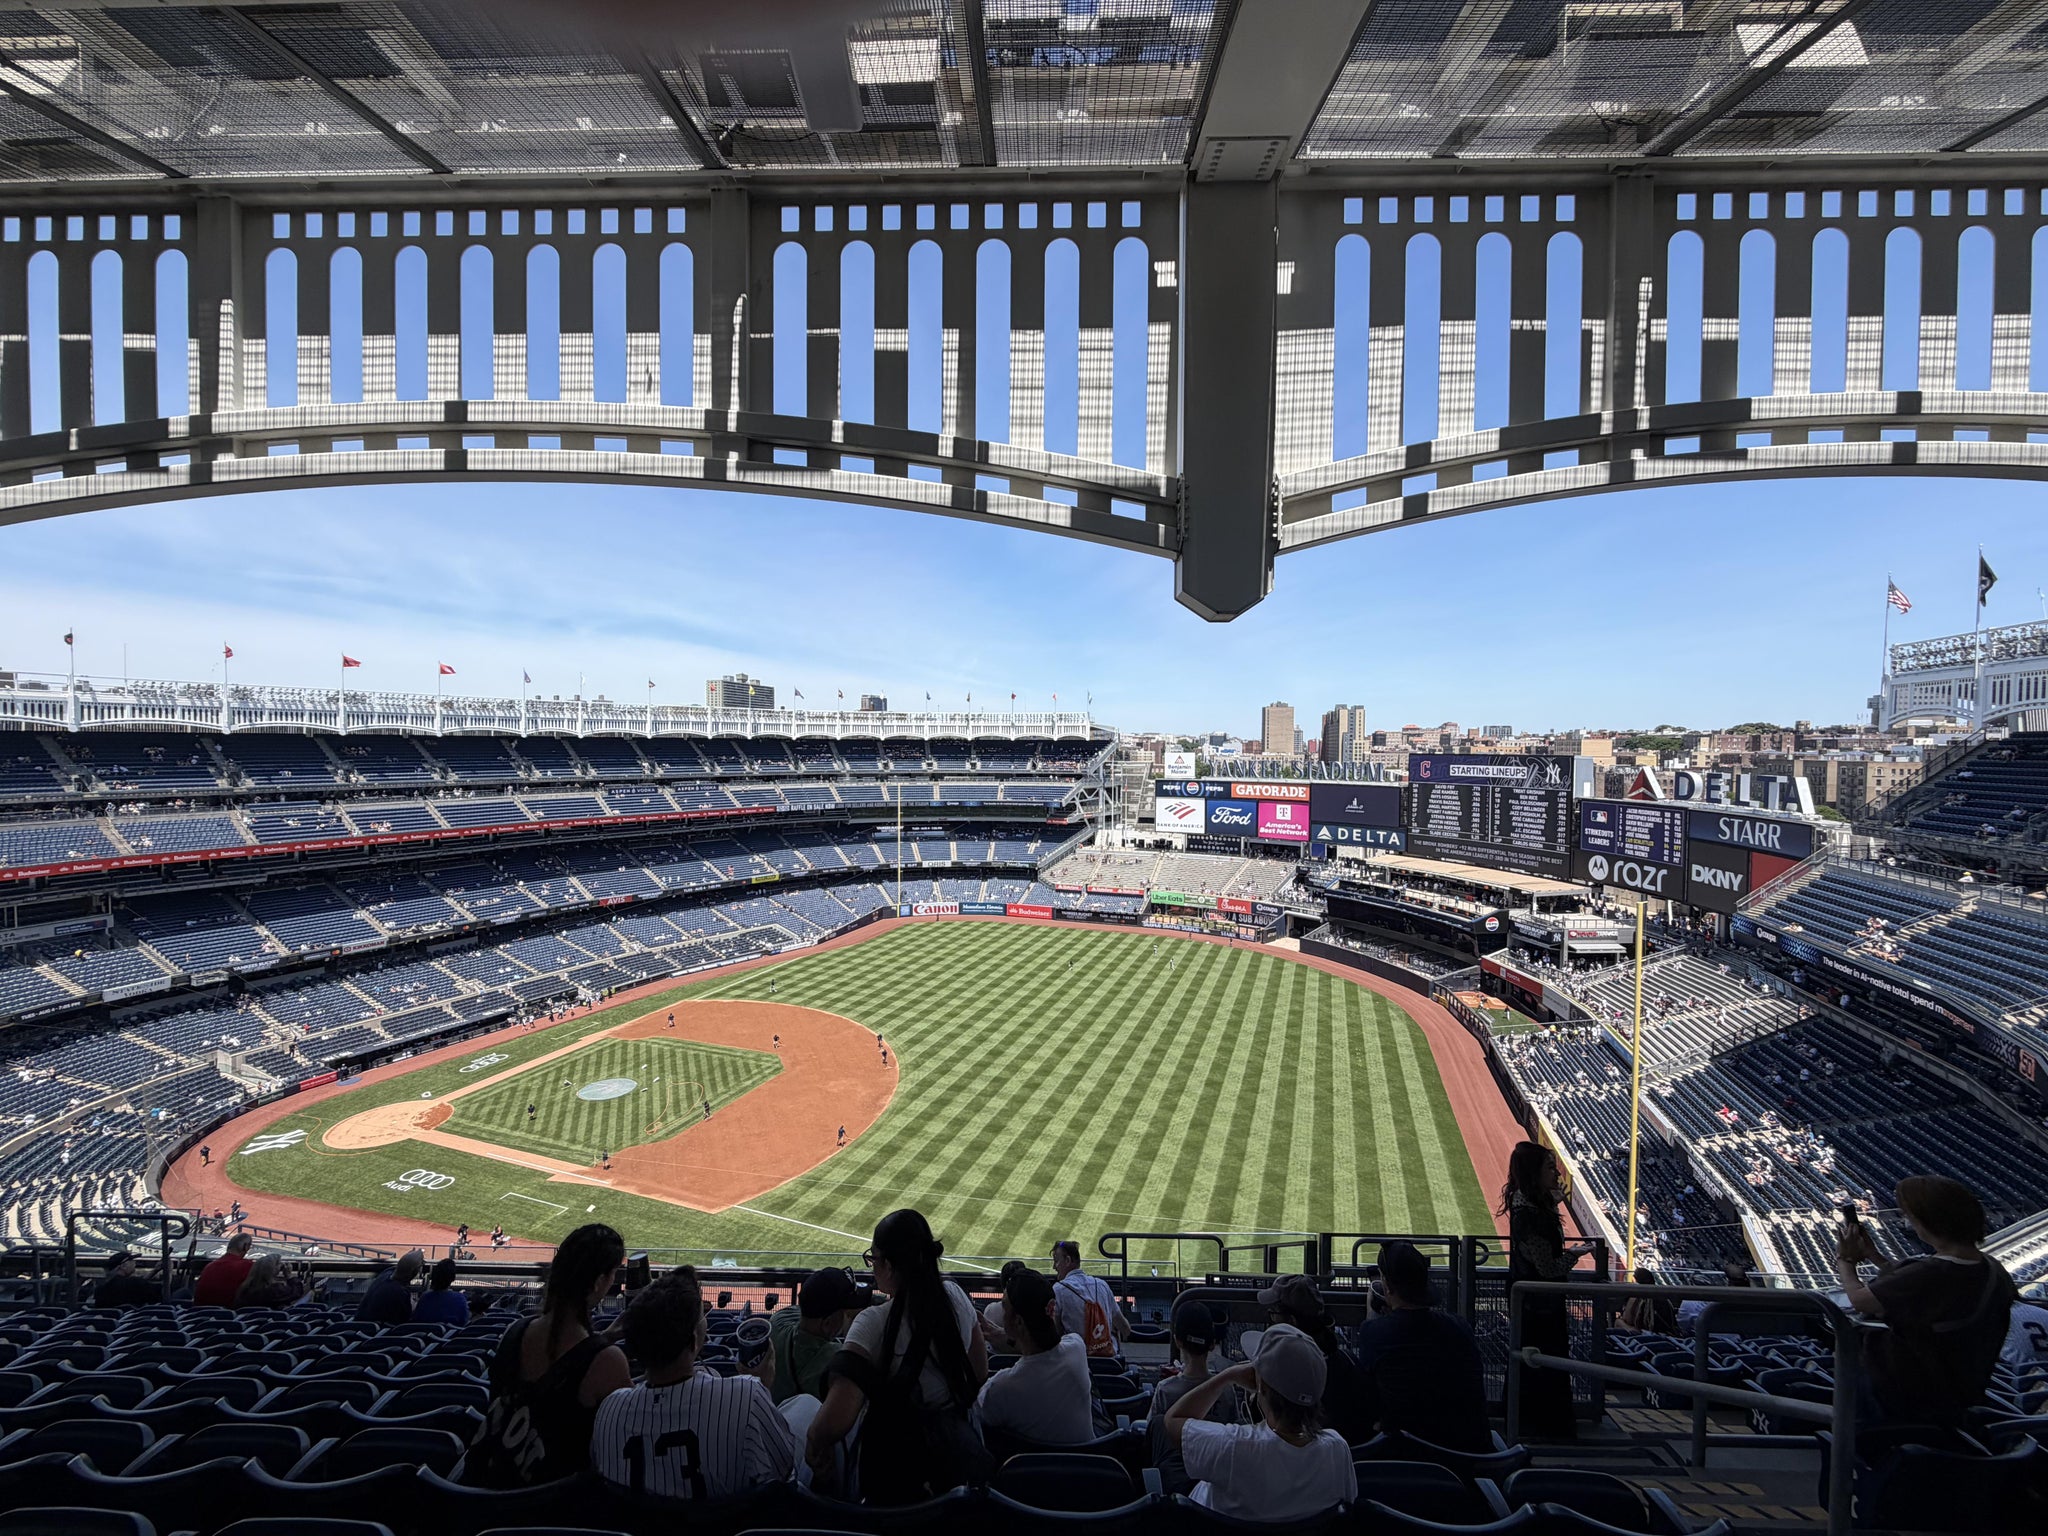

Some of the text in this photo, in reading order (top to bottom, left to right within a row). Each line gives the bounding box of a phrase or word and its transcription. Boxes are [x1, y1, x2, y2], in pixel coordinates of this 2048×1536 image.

[1209, 759, 1385, 782] YANKEE STADIUM
[1451, 767, 1526, 778] STARTING LINEUPS
[1236, 785, 1306, 798] GATORADE
[1674, 769, 1815, 815] DELTA
[1211, 806, 1252, 825] Ford
[1276, 828, 1307, 836] Network
[1338, 828, 1400, 846] DELTA
[1585, 828, 1614, 838] STRIKEOUTS
[1718, 817, 1781, 850] STARR
[1588, 837, 1609, 846] LEADERS
[1450, 849, 1472, 857] AMERICAN
[1478, 846, 1507, 856] DIFFERENTIAL
[1519, 852, 1535, 860] SEASON
[18, 869, 50, 877] Budweiser
[73, 864, 102, 872] Budweiser
[1613, 860, 1668, 892] razr
[1691, 863, 1743, 891] DKNY
[607, 896, 626, 905] AVIS
[914, 903, 958, 914] Canon
[1019, 908, 1049, 916] Budweiser
[1239, 914, 1252, 923] SUB
[353, 940, 385, 950] KIKKOMAN
[233, 959, 280, 972] YANKEES BUCKET
[1506, 972, 1520, 982] TOYOTA
[1823, 956, 1975, 1034] The leader in AI-native total spend management
[381, 1179, 413, 1192] Audi
[623, 1429, 707, 1502] 13
